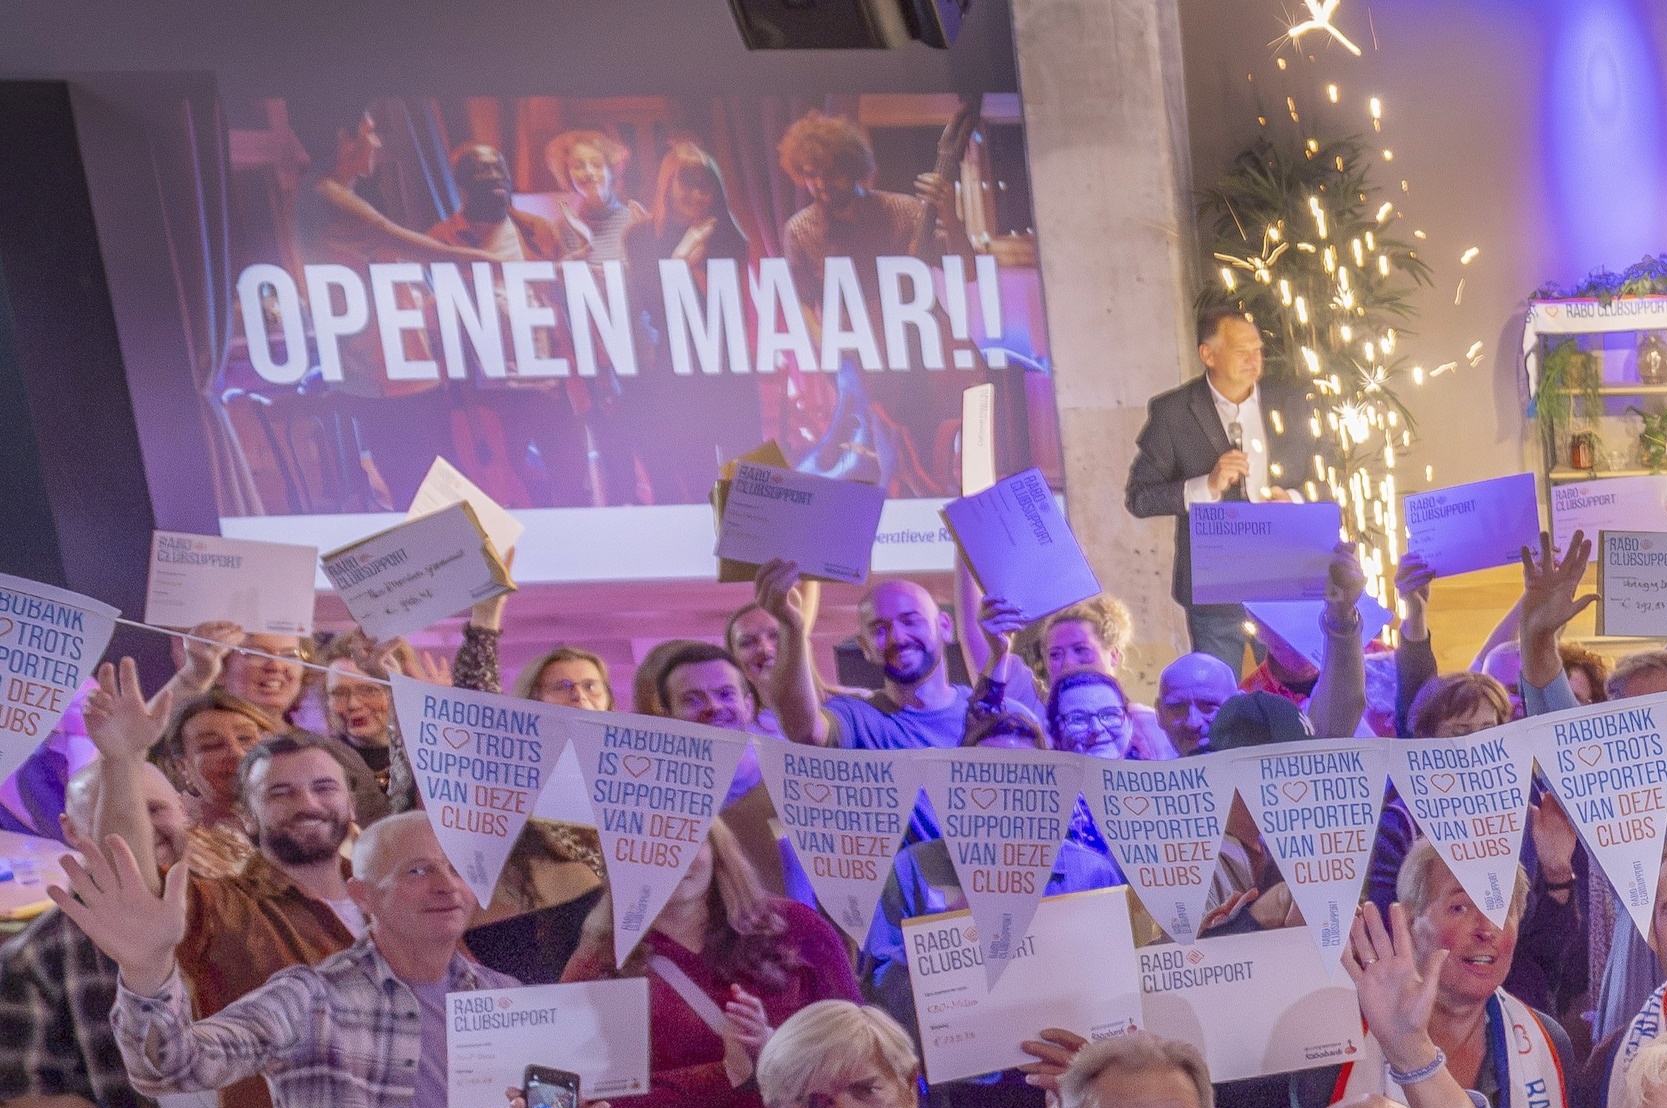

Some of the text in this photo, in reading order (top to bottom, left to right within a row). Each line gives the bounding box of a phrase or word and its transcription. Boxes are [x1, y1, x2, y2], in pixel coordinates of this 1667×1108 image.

[236, 255, 1007, 384] OPENEN MAAR!!
[1566, 303, 1595, 318] RABO
[1195, 521, 1273, 536] CLUBSUPPORT
[1196, 507, 1225, 521] RABO
[1609, 537, 1639, 551] RABO
[424, 695, 540, 737] RABOBANK
[1554, 708, 1656, 747] RABOBANK
[419, 721, 542, 763] IS TROTS
[1557, 734, 1664, 773] IS TROTS
[416, 748, 541, 790] SUPPORTER
[784, 753, 895, 784] RABOBANK
[1102, 766, 1210, 793] RABOBANK
[427, 776, 528, 815] VAN DEZE
[783, 779, 899, 809] IS TROTS
[1103, 792, 1216, 817] IS TROTS
[1575, 787, 1666, 824] VAN DEZE
[441, 805, 509, 838] CLUBS
[783, 805, 900, 834] SUPPORTER
[1105, 817, 1220, 842] SUPPORTER
[1596, 816, 1657, 849] CLUBS
[796, 830, 892, 859] VAN DEZE
[1119, 840, 1214, 864] VAN DEZE
[813, 856, 878, 881] CLUBS
[1138, 865, 1203, 889] CLUBS
[914, 928, 963, 955] RABO
[1140, 949, 1184, 974] RABO
[1142, 961, 1254, 994] CLUBSUPPORT
[453, 996, 494, 1015] RABO
[454, 1008, 557, 1033] CLUBSUPPORT
